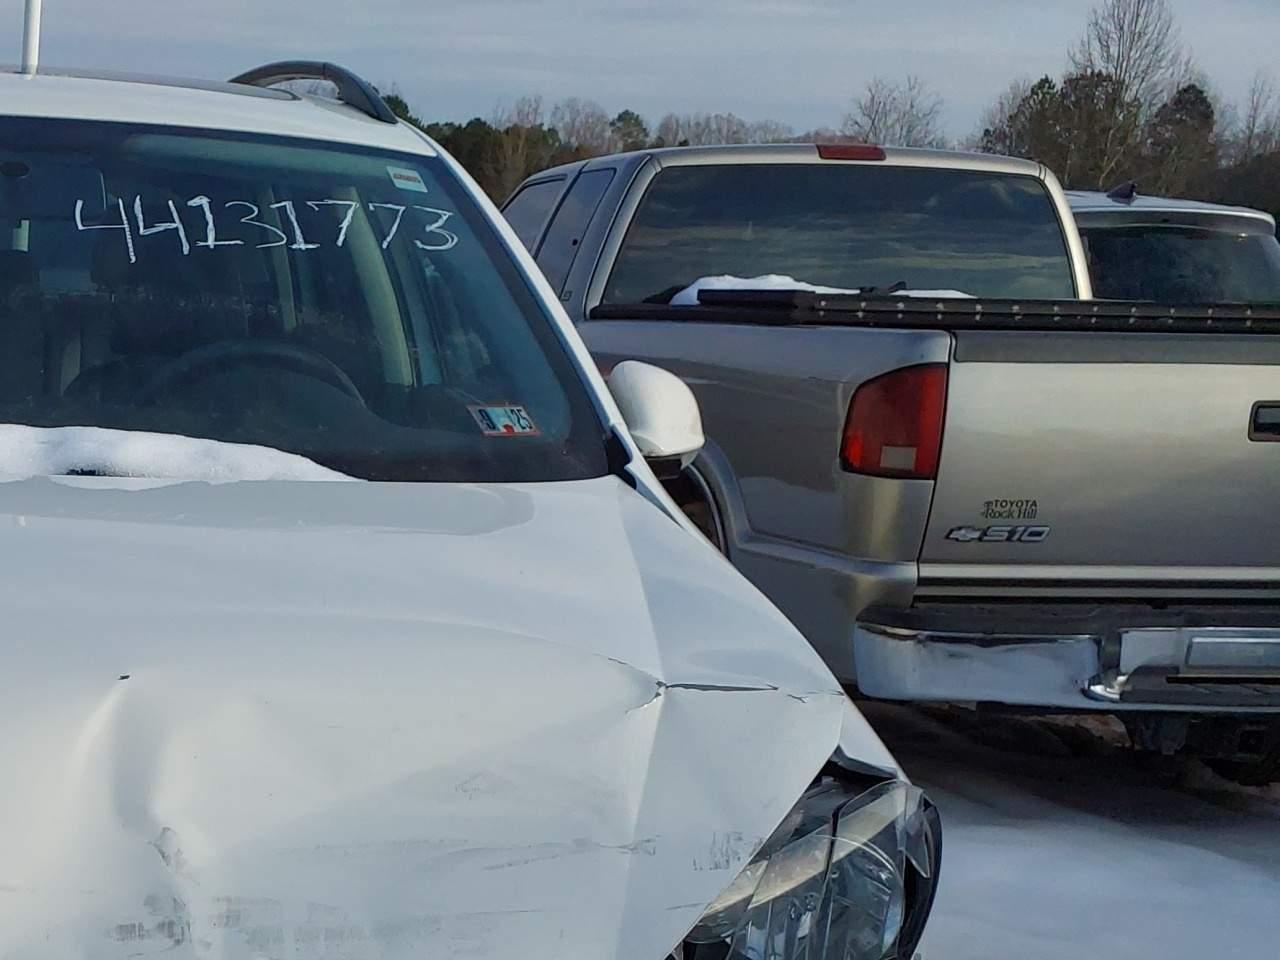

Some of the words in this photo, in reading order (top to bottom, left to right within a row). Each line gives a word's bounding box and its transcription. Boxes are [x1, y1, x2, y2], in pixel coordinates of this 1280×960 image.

[75, 195, 460, 264] 44131773
[509, 408, 534, 430] 25
[994, 499, 1038, 508] TOYOTA
[981, 525, 1051, 541] S10
